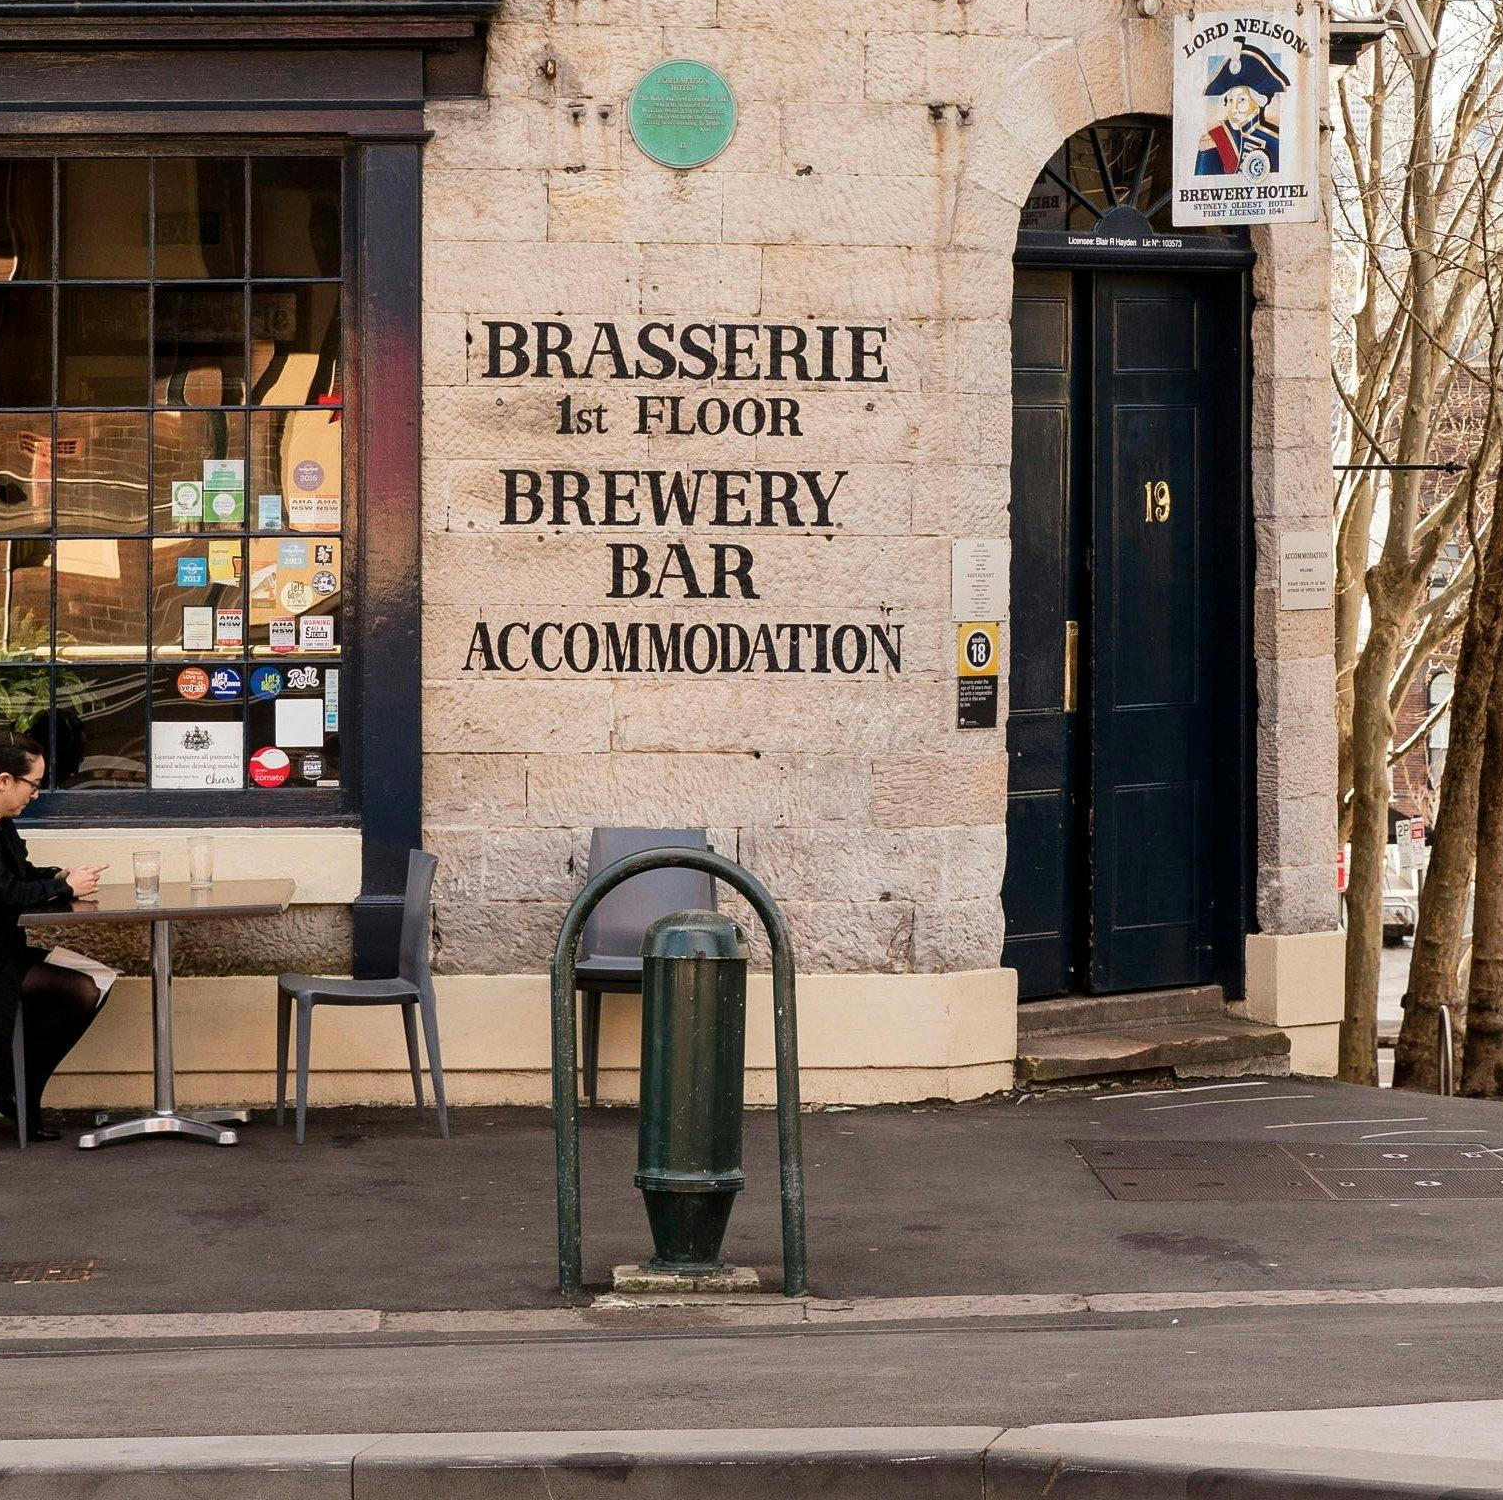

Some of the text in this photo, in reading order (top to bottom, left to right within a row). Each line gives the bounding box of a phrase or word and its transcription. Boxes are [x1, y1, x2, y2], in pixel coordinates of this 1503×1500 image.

[1182, 18, 1309, 59] LORD NELSON
[1179, 184, 1309, 203] BREWERY HOTEL
[1203, 209, 1227, 218] FIRST
[1229, 208, 1266, 217] LICENSED
[1231, 201, 1263, 209] OLDEST
[1268, 200, 1295, 208] HOTEL
[1068, 237, 1095, 246] Licensee:
[1096, 237, 1109, 246] Blair
[1116, 238, 1137, 248] Hayden
[481, 320, 889, 383] BRASSERIE
[556, 394, 803, 437] 1st FLOOR
[499, 468, 848, 528] BREWERY
[1144, 480, 1171, 523] 19
[606, 542, 761, 600] BAR
[461, 621, 905, 674] ACCOMMODATION
[971, 643, 986, 663] 18
[205, 772, 236, 785] Cheers
